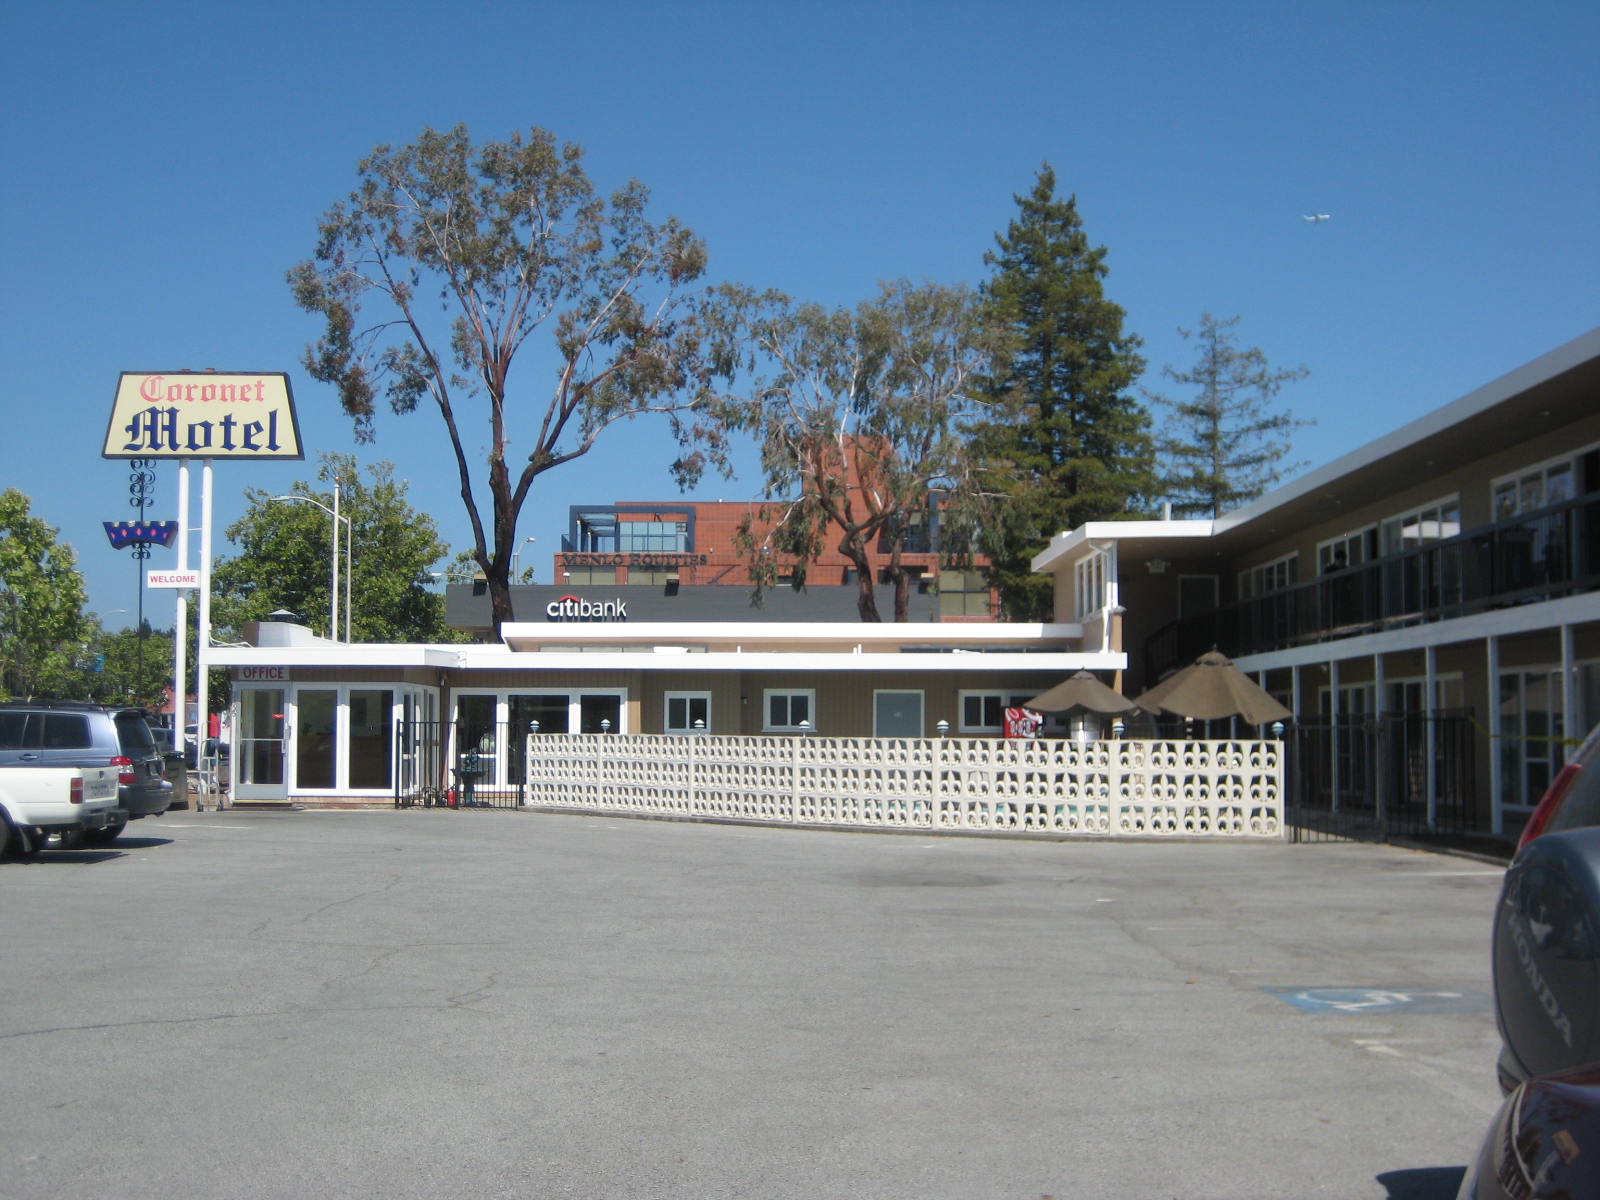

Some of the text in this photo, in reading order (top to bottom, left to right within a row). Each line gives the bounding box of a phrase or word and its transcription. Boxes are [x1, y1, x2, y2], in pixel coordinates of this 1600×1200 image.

[140, 375, 265, 402] Coronet
[123, 406, 281, 452] Motel
[563, 553, 708, 566] MENLO EQUITIES
[150, 575, 196, 583] WELCOME
[547, 598, 627, 617] citibank
[243, 666, 284, 679] OFFICE
[1507, 911, 1573, 1048] HONDA
